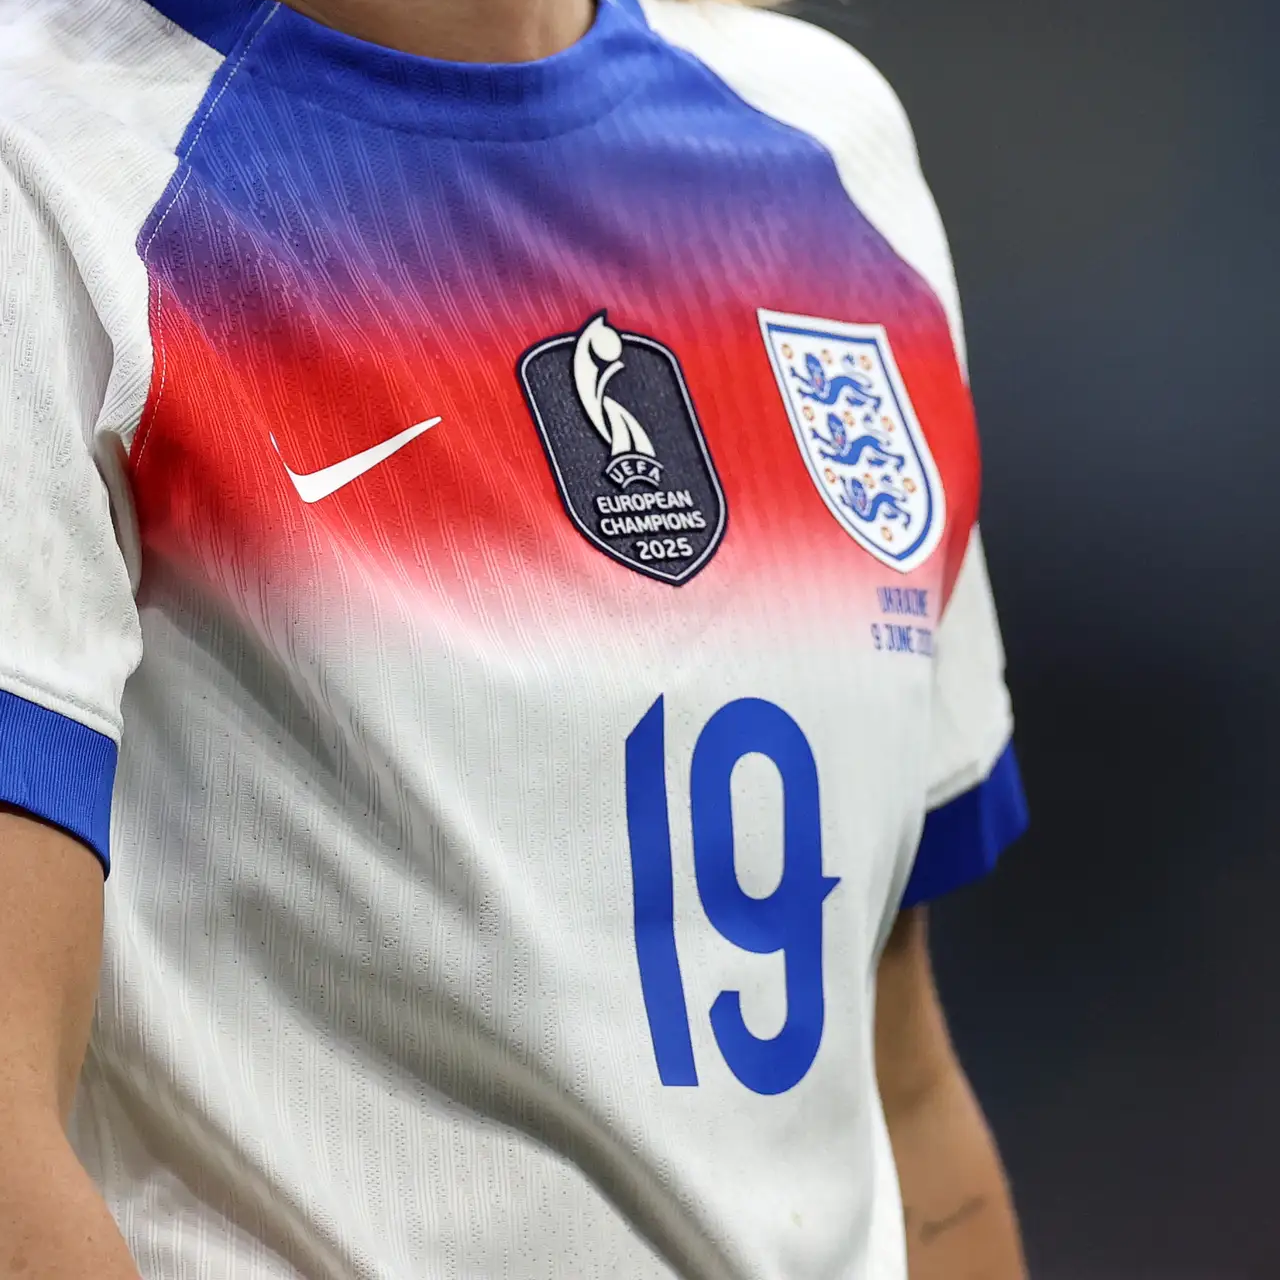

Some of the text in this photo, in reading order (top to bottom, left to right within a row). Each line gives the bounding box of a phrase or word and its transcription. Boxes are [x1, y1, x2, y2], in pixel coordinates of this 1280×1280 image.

[609, 461, 662, 484] UEFA
[596, 490, 693, 514] EUROPEAN
[600, 511, 706, 536] CHAMPIONS
[636, 537, 693, 560] 2025
[870, 622, 882, 650] 9
[884, 623, 914, 653] JUNE
[625, 693, 841, 1096] 19
